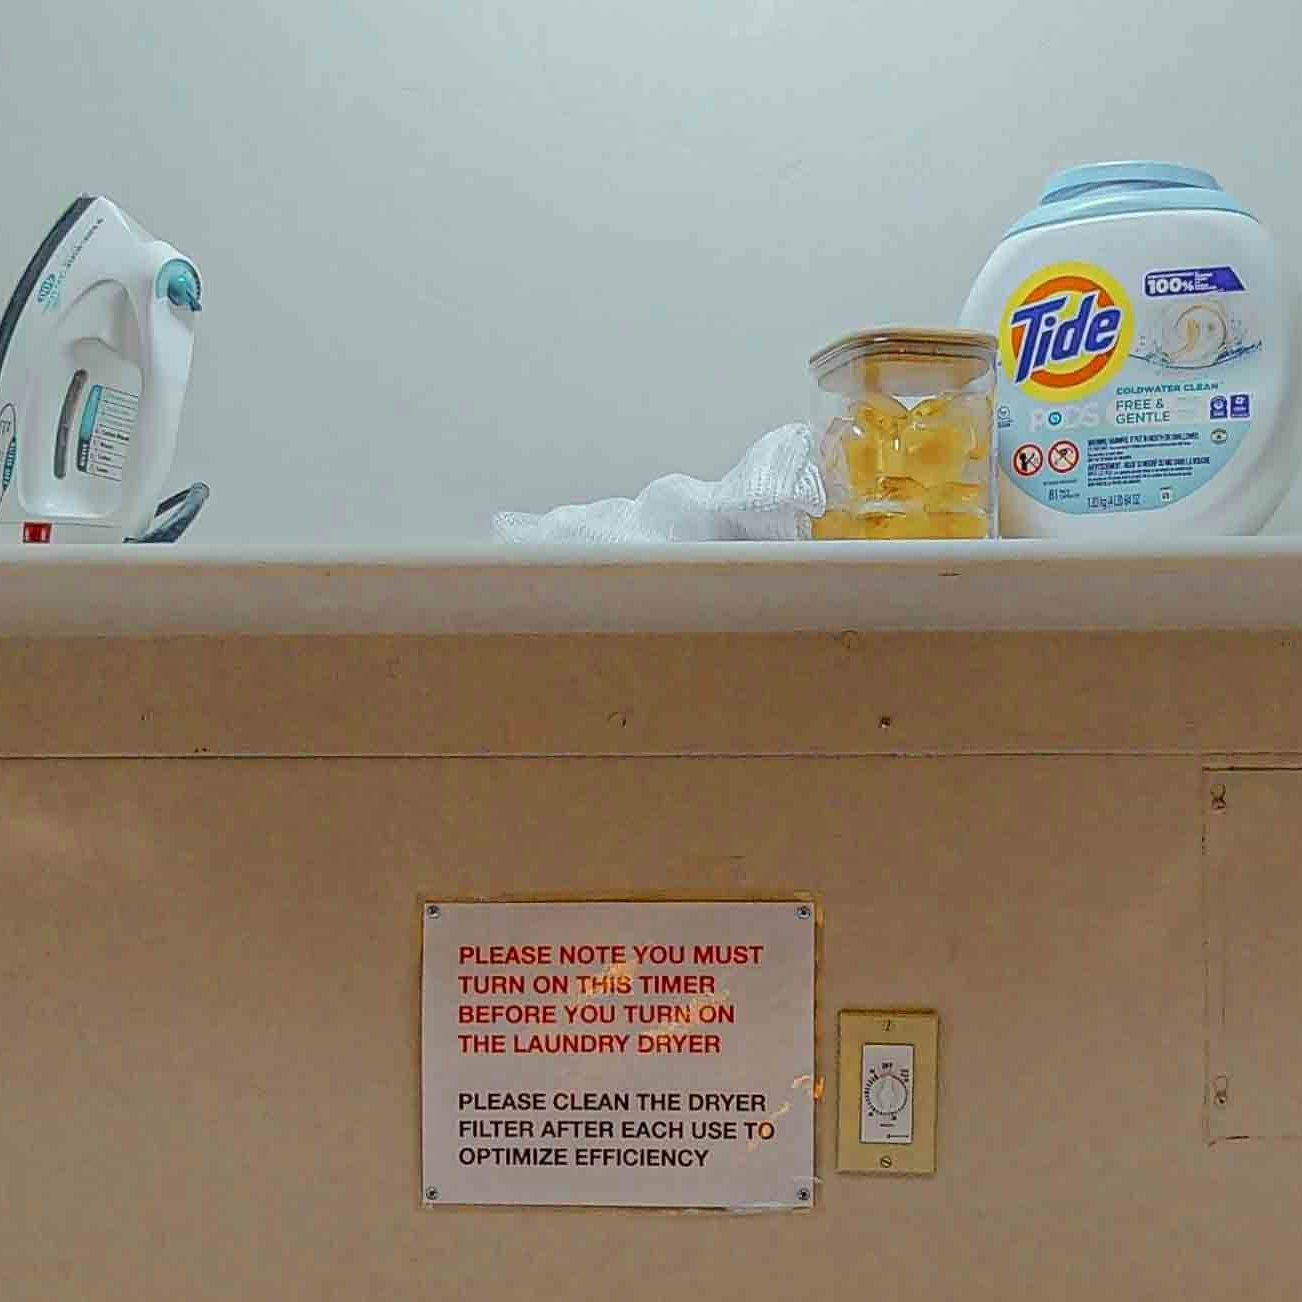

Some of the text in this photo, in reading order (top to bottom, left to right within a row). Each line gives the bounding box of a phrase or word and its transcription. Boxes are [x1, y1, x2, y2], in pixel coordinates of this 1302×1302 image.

[1011, 291, 1121, 384] Tide
[1116, 383, 1219, 396] COLDWATER CLEAN
[1116, 398, 1164, 411] FREE &
[1116, 411, 1171, 424] GENTLE
[459, 946, 763, 965] PLEASE NOTE YOU MUST
[458, 975, 715, 995] TURN ON THIS TIMER
[458, 1005, 735, 1024] BEFORE YOU TURN ON
[458, 1034, 720, 1054] THE LAUNDRY DRYER
[458, 1093, 765, 1112] PLEASE CLEAN THE DRYER
[458, 1121, 774, 1140] FILTER AFTER EACH USE TO
[458, 1148, 709, 1168] OPTIMIZE EFFICIENCY
